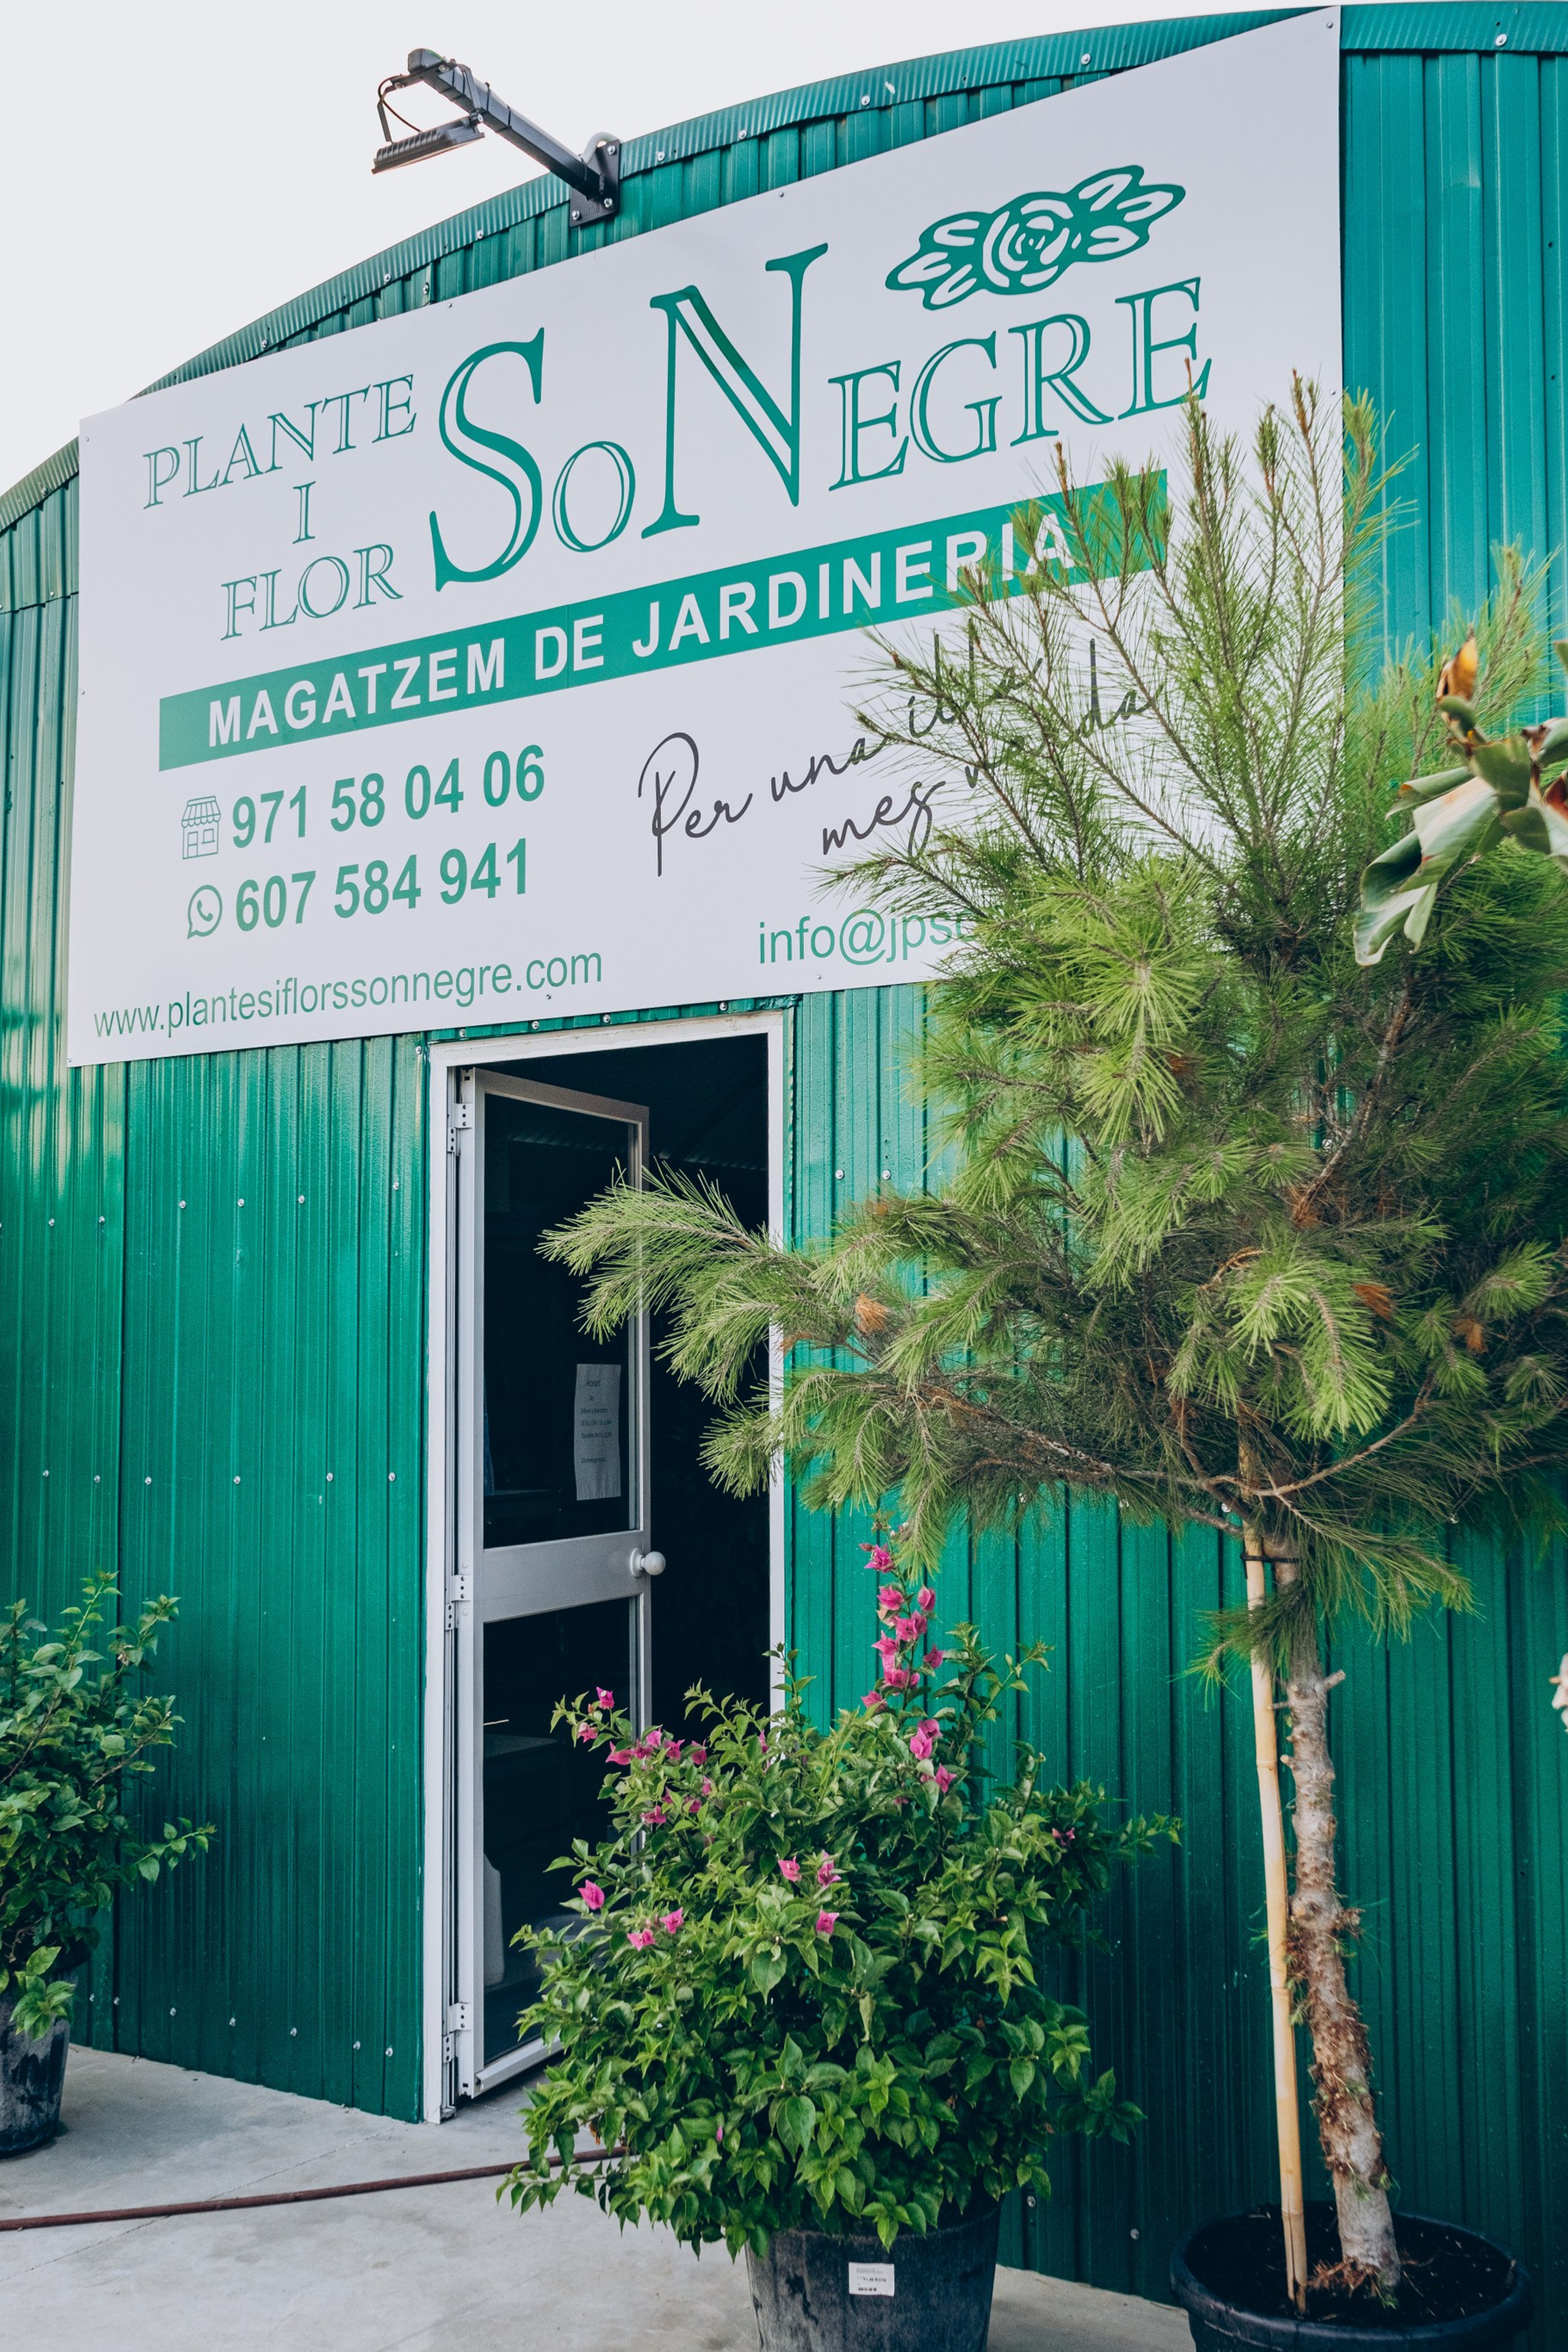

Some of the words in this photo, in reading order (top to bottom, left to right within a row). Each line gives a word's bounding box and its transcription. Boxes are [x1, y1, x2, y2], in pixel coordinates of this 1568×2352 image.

[143, 374, 418, 510] PLANTE
[292, 481, 317, 545] I
[208, 638, 505, 748] MAGATZEM
[535, 614, 605, 680] DE
[632, 513, 1076, 658] JARDINERIA
[220, 543, 404, 641] FLOR
[232, 785, 307, 849] 971
[330, 772, 386, 832] 58
[404, 757, 465, 821] 04
[483, 744, 545, 809] 06
[637, 731, 753, 877] Per
[770, 733, 889, 803] una
[235, 870, 317, 932] 607
[334, 853, 422, 919] 584
[439, 837, 527, 905] 941
[94, 951, 603, 1039] www.plantesiflorssonnegre.com
